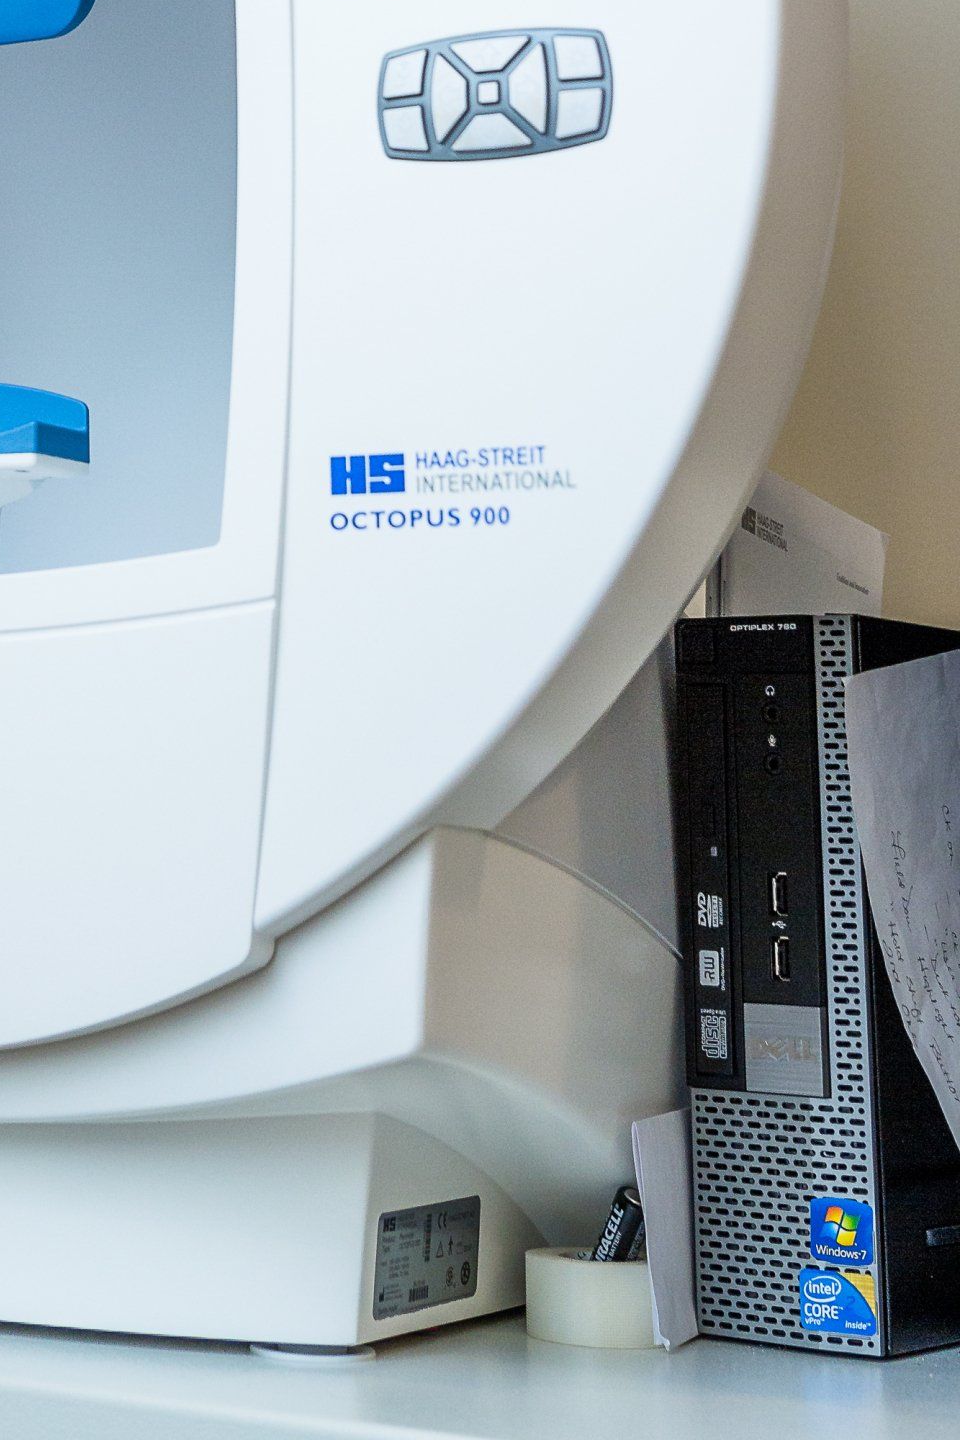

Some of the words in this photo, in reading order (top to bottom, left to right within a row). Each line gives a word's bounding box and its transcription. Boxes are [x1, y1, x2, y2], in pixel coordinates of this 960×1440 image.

[415, 445, 546, 470] HAAG-STREIT
[330, 453, 406, 496] HS
[415, 470, 577, 495] INTERNATIONAL
[330, 507, 461, 531] OCTOPUS
[469, 505, 511, 527] 900
[729, 622, 775, 632] OPTIPLEX
[697, 891, 708, 927] DVD
[703, 956, 716, 981] RW
[815, 1243, 859, 1260] Windows
[808, 1279, 836, 1296] intel
[804, 1302, 840, 1320] CORE
[804, 1316, 822, 1326] vPro
[844, 1319, 868, 1331] inside
